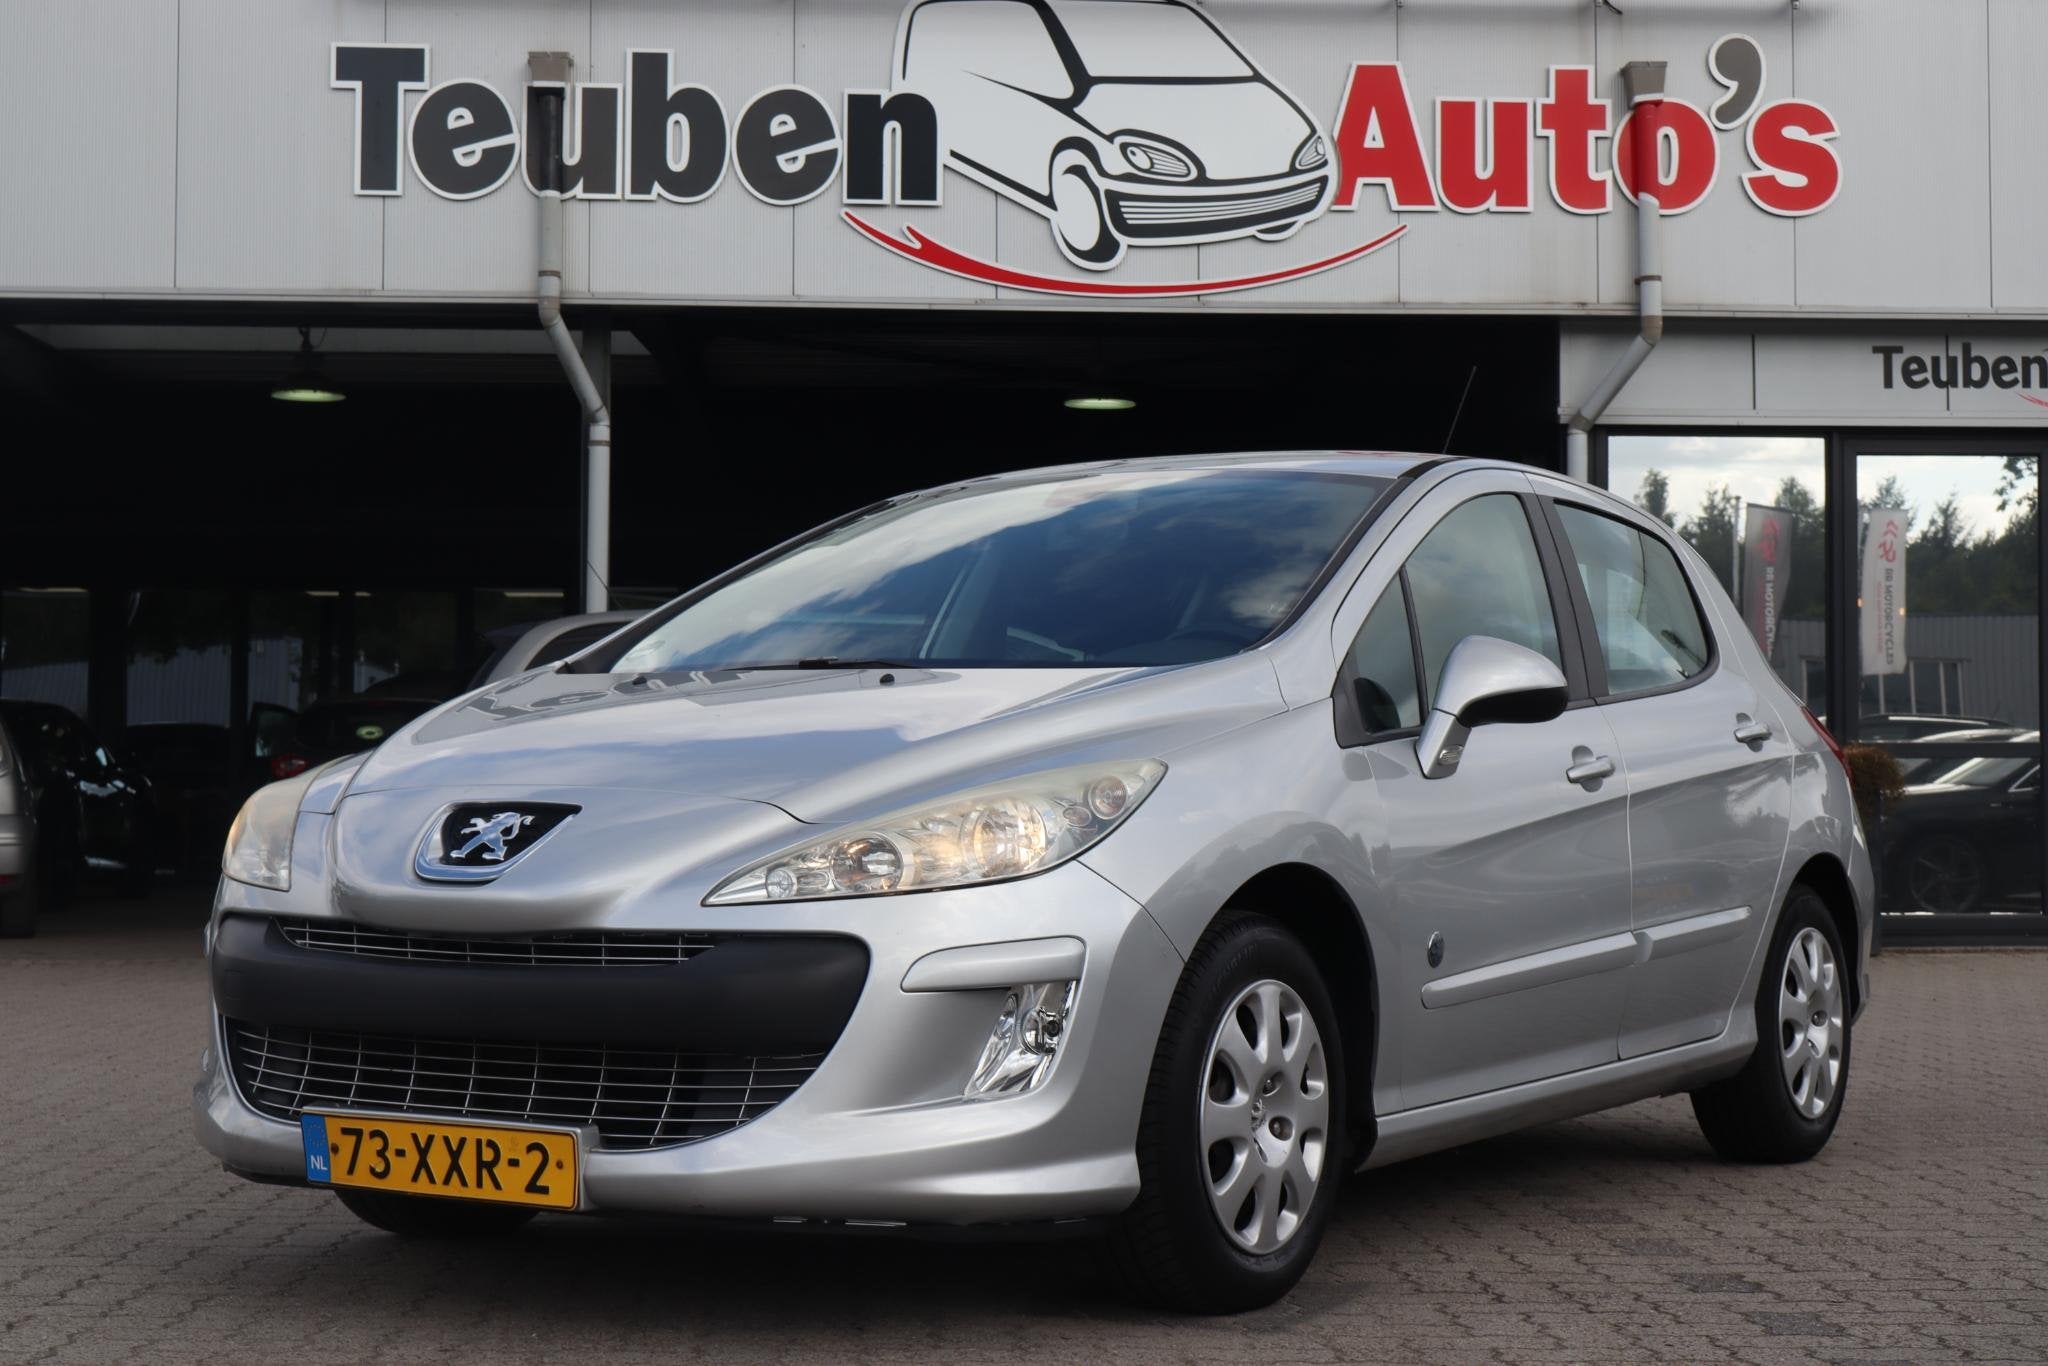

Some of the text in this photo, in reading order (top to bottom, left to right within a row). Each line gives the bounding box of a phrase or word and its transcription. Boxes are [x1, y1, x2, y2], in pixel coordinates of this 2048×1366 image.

[332, 34, 1841, 216] Teuben Auto's
[1872, 342, 2048, 389] Teuben
[310, 1155, 328, 1171] NL
[340, 1126, 551, 1196] 73-XXR-2
